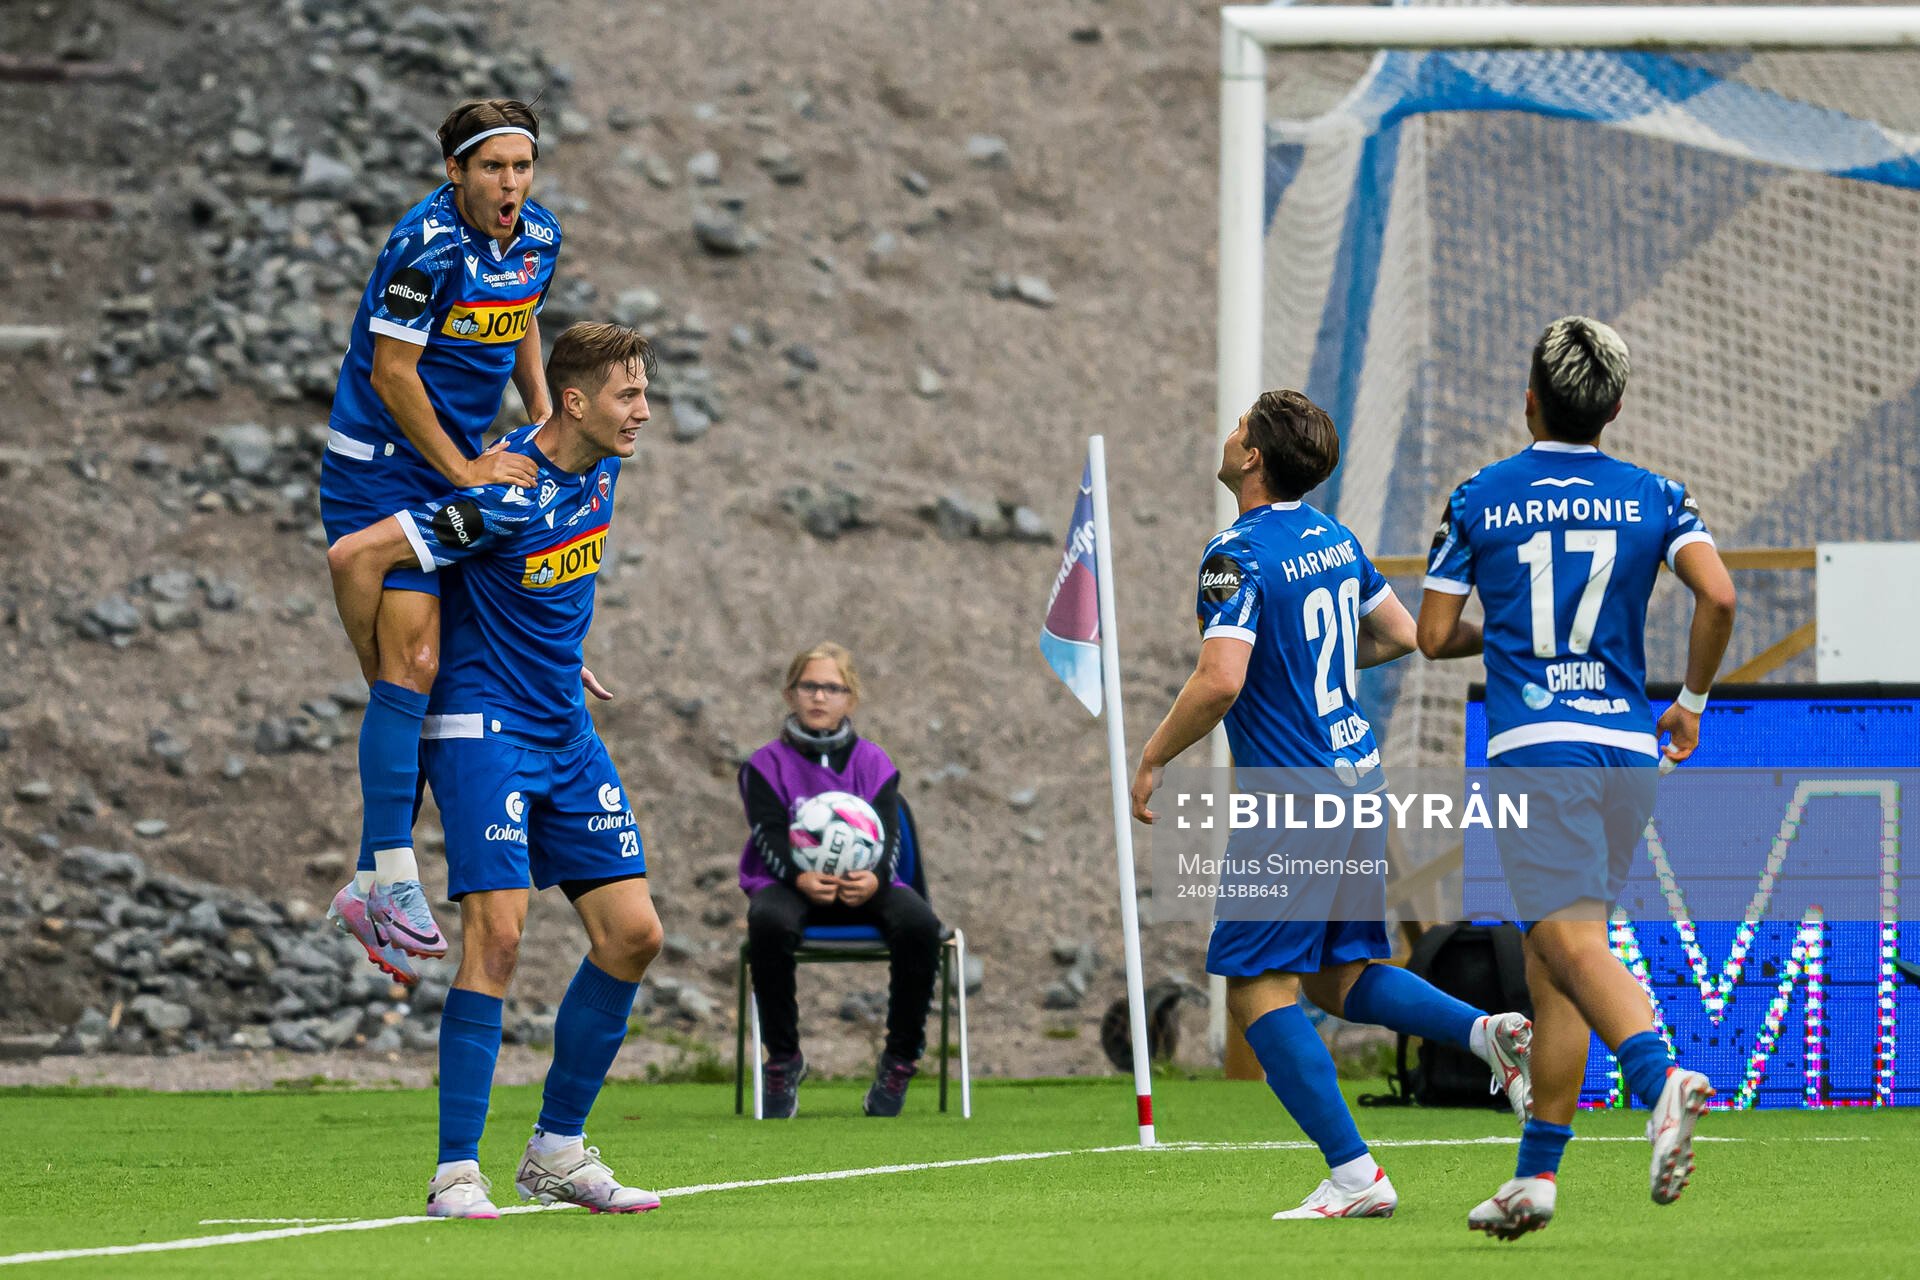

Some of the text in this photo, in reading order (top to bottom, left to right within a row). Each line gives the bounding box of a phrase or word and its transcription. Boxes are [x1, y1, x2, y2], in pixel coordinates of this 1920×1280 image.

[527, 221, 554, 243] BDO
[388, 283, 429, 304] altibox
[446, 505, 471, 544] altibox
[1483, 498, 1643, 531] HARMONIE
[1517, 530, 1617, 658] 17
[1303, 577, 1360, 718] 20
[1546, 661, 1606, 693] CHENG
[485, 824, 521, 841] Color
[588, 813, 624, 832] Color
[619, 830, 639, 858] 23
